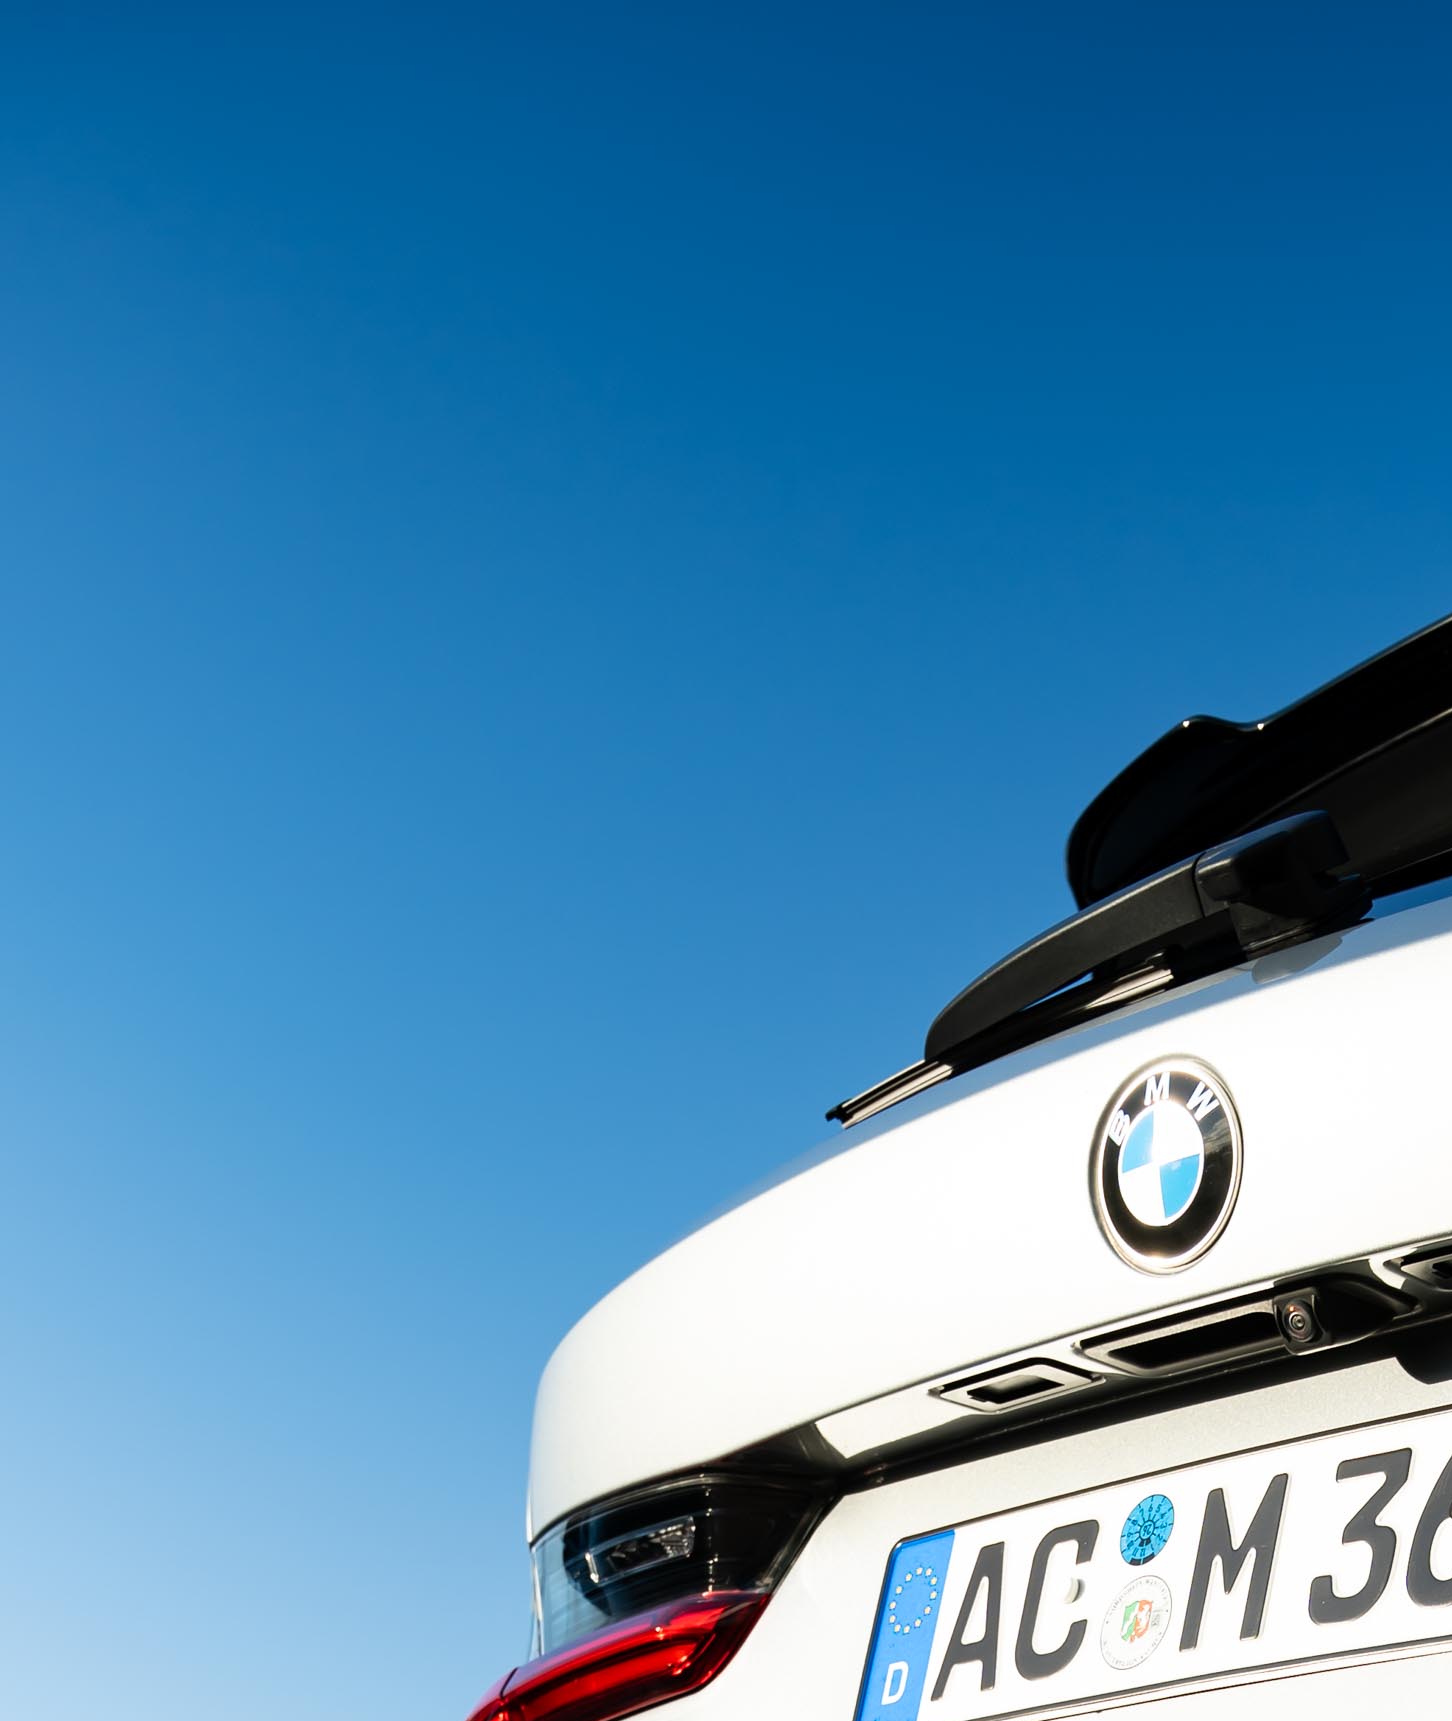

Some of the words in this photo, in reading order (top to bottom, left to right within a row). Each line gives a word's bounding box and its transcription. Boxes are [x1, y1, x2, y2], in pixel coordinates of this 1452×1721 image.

[1108, 1071, 1220, 1146] BMW
[930, 1519, 1100, 1702] AC
[1179, 1473, 1289, 1652] M
[881, 1660, 909, 1706] D
